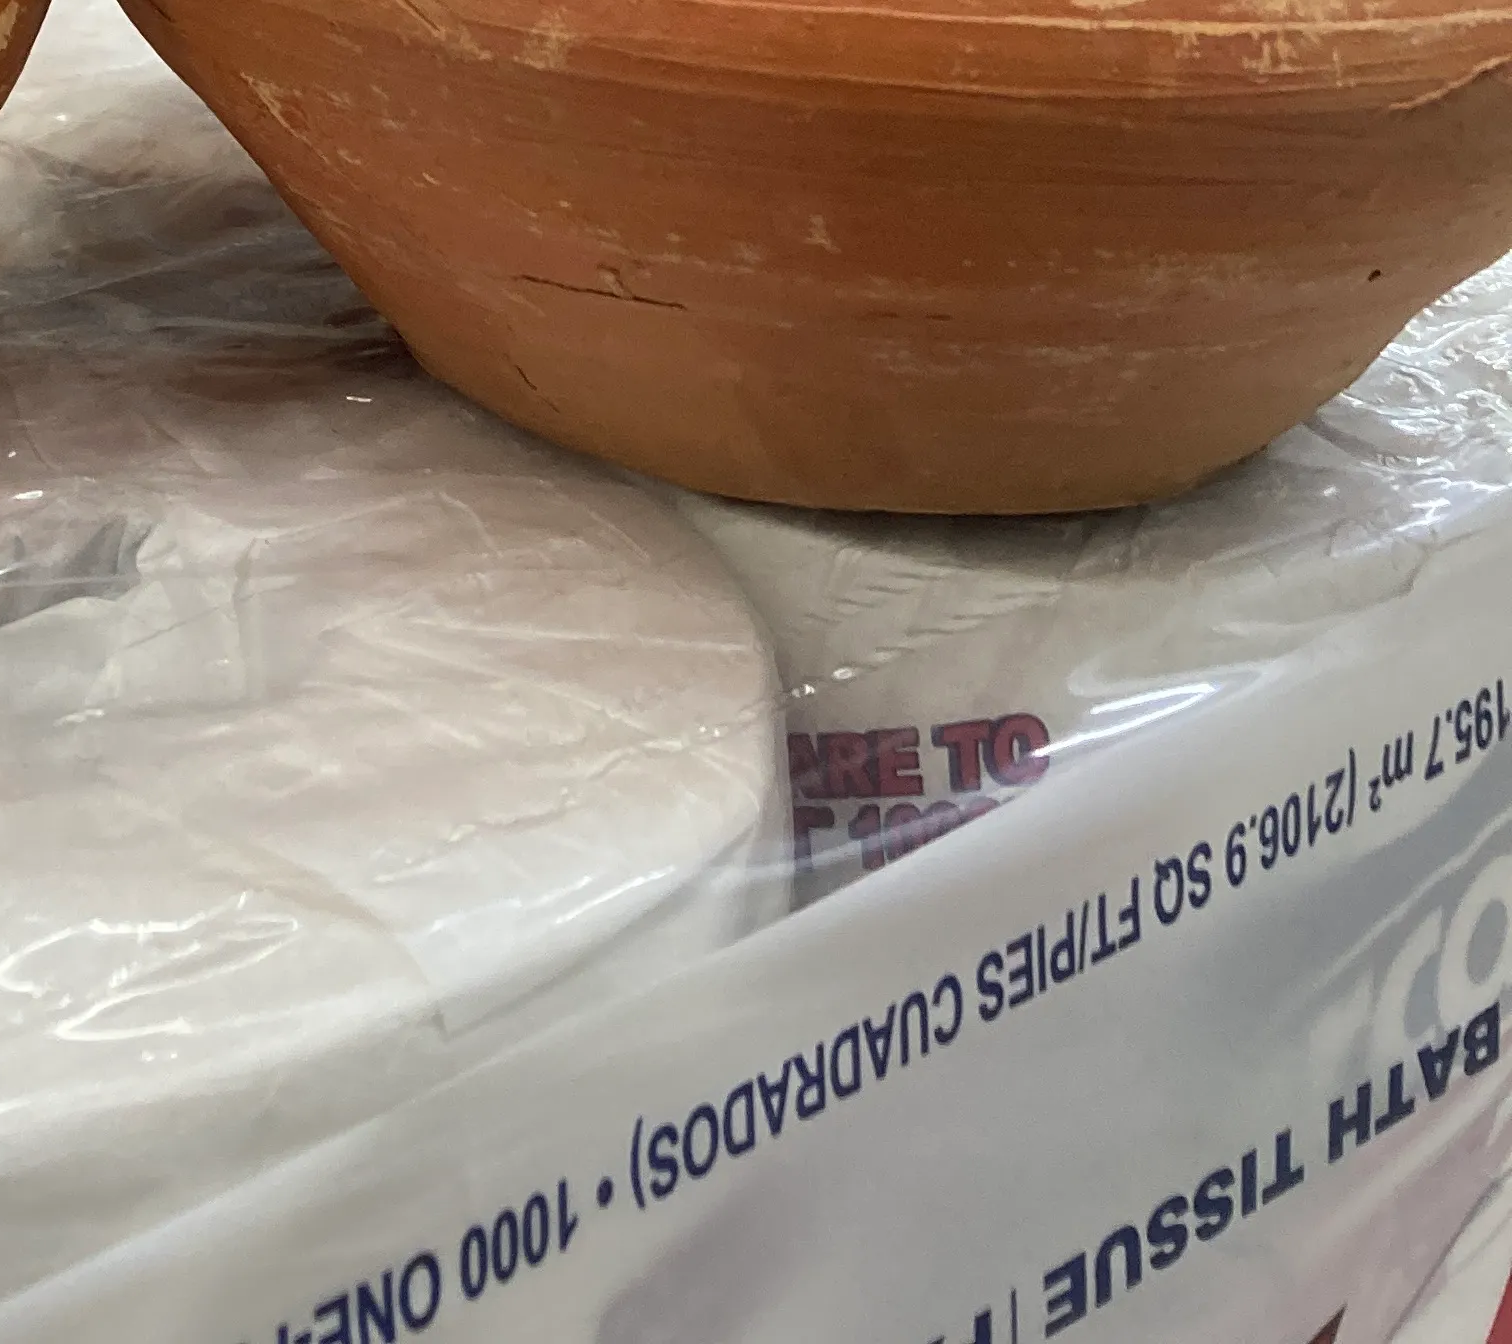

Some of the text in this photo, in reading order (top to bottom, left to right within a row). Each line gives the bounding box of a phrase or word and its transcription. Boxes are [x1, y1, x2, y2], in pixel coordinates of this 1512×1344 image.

[931, 713, 1050, 792] TO
[1424, 677, 1512, 782] 195.7
[1225, 744, 1355, 887] (2106.9
[978, 872, 1143, 1022] FT/PIES
[1153, 839, 1213, 927] SQ
[628, 972, 963, 1210] CUADRADOS)
[458, 1174, 579, 1300] 1000
[1042, 1002, 1500, 1339] BATH TISSUE
